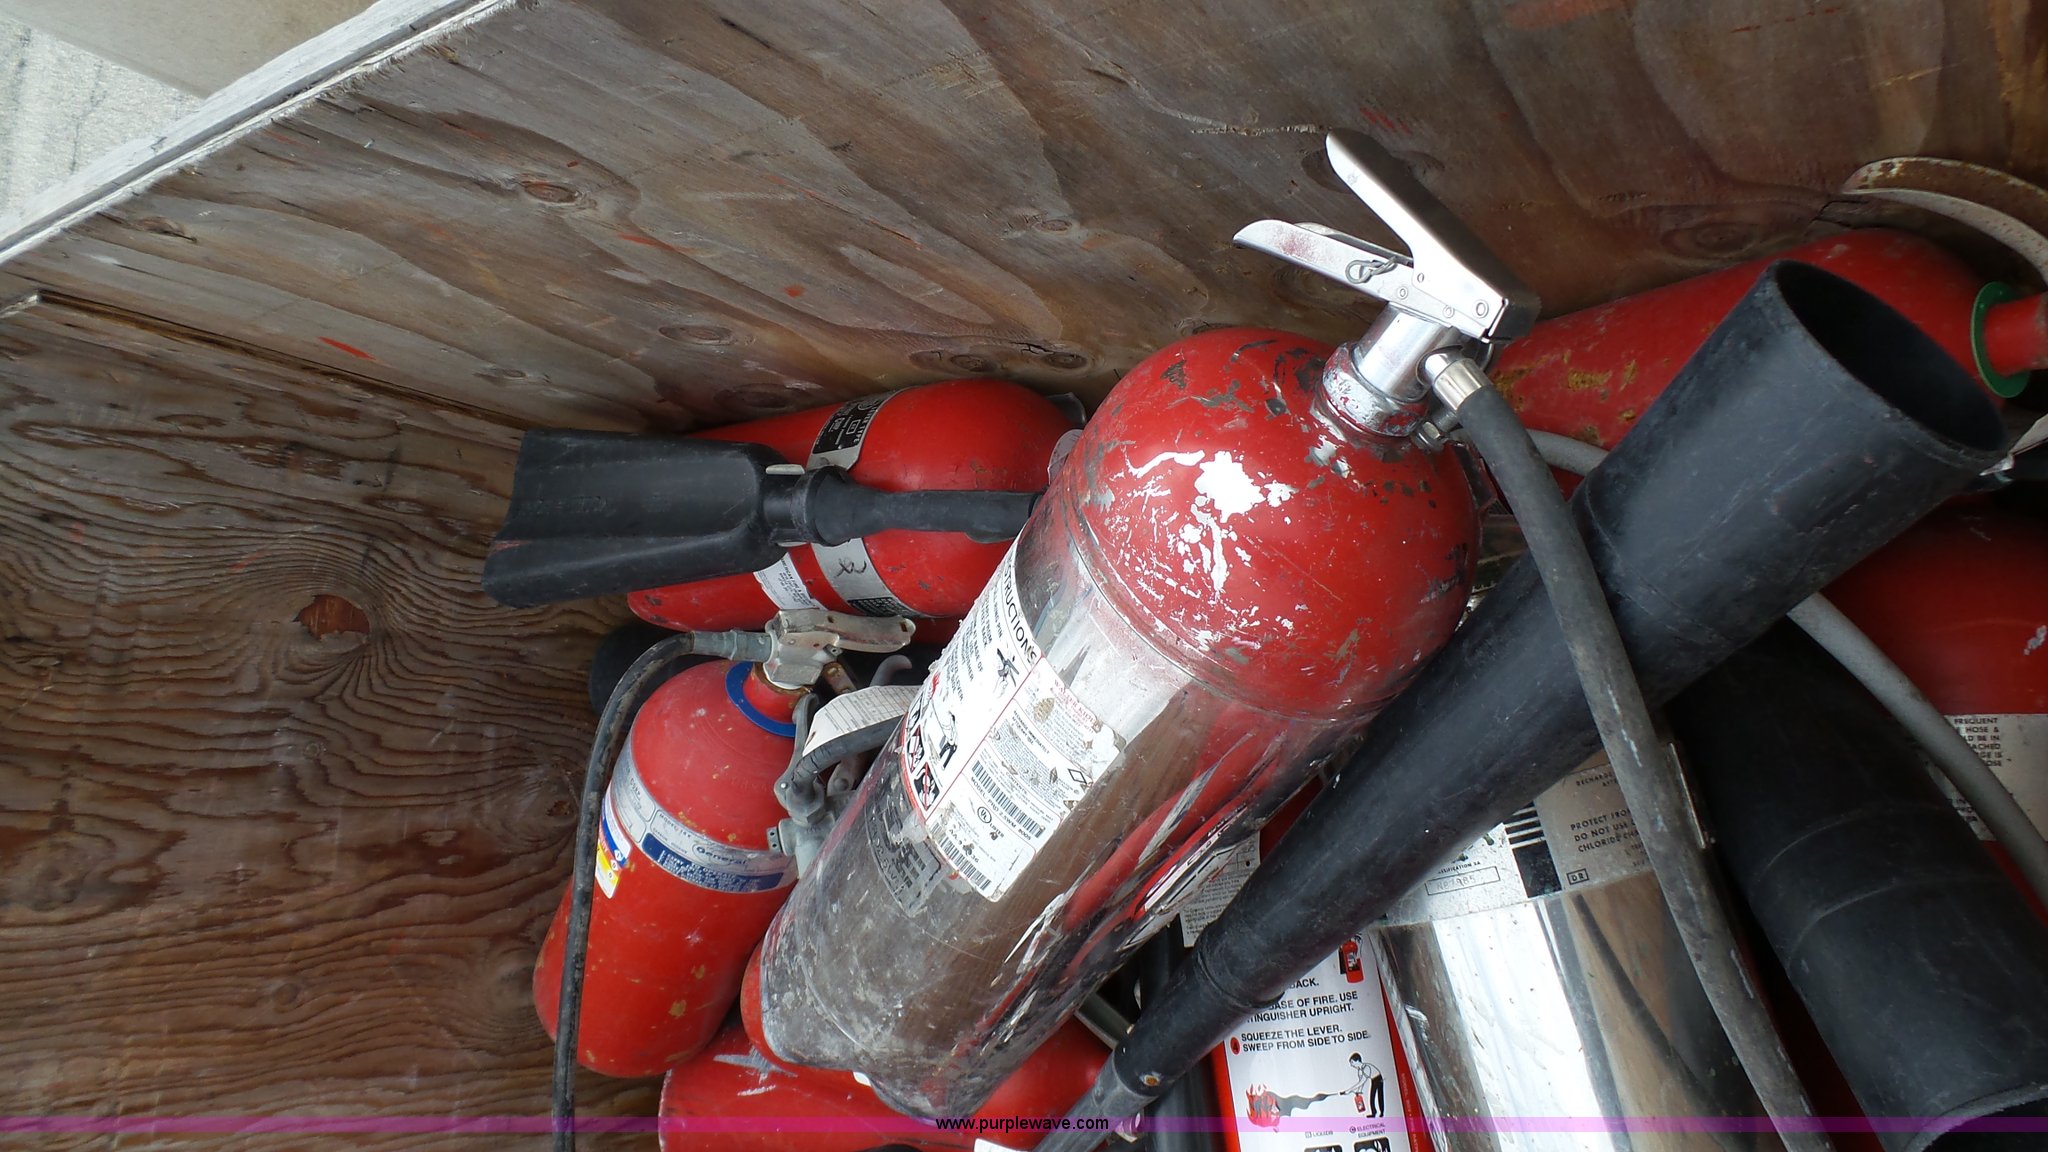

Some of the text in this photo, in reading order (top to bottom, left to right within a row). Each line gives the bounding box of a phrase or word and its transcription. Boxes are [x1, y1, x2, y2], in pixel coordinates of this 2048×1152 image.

[1003, 552, 1037, 663] STRUCTIONS
[1954, 717, 1999, 725] FREQUENT
[1570, 814, 1608, 831] PROTECT
[1573, 822, 1629, 842] DO NOT USE
[1577, 835, 1620, 853] CHLORIDE
[696, 845, 747, 865] General
[1296, 997, 1311, 1008] OF
[1313, 994, 1338, 1006] FIRE.
[1339, 990, 1359, 1002] USE
[1247, 1002, 1355, 1023] INGUISHER UPRIGHT.
[1241, 1023, 1343, 1042] SQUEEZE THE LEVER.
[1243, 1030, 1372, 1053] SWEEP FROM SIDE TO SIDE.
